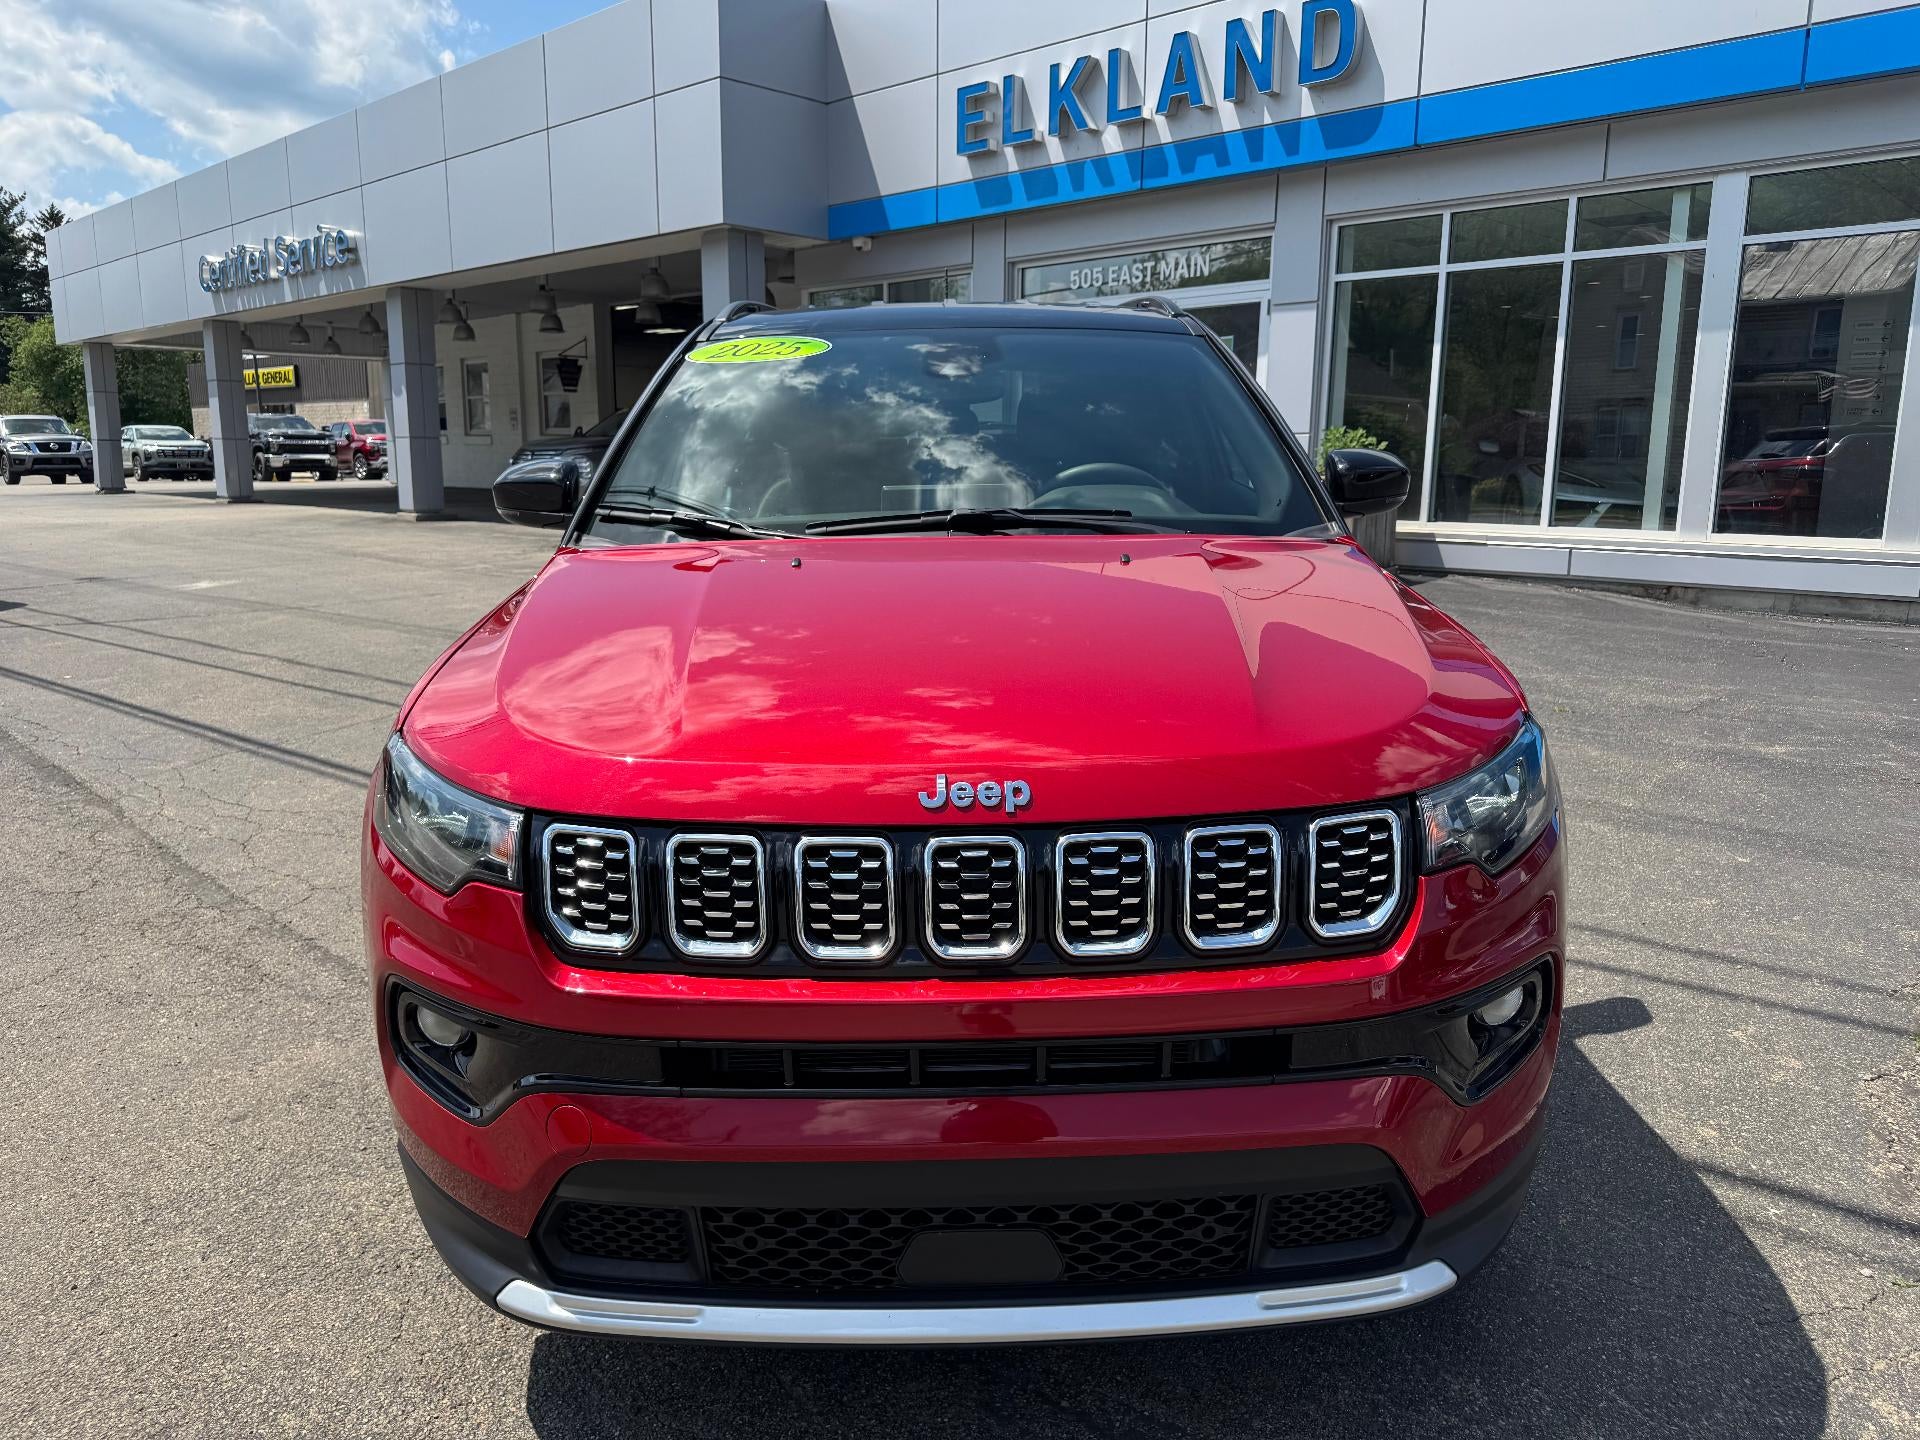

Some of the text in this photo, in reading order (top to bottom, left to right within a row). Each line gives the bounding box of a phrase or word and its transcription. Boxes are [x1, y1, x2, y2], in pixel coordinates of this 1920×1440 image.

[957, 0, 1361, 156] ELKLAND
[199, 224, 351, 292] Certified Service
[1070, 253, 1211, 290] 505 EAST MAIN
[706, 341, 811, 359] 2025
[245, 369, 292, 386] LLA GENERAL
[918, 773, 1031, 813] Jeep
